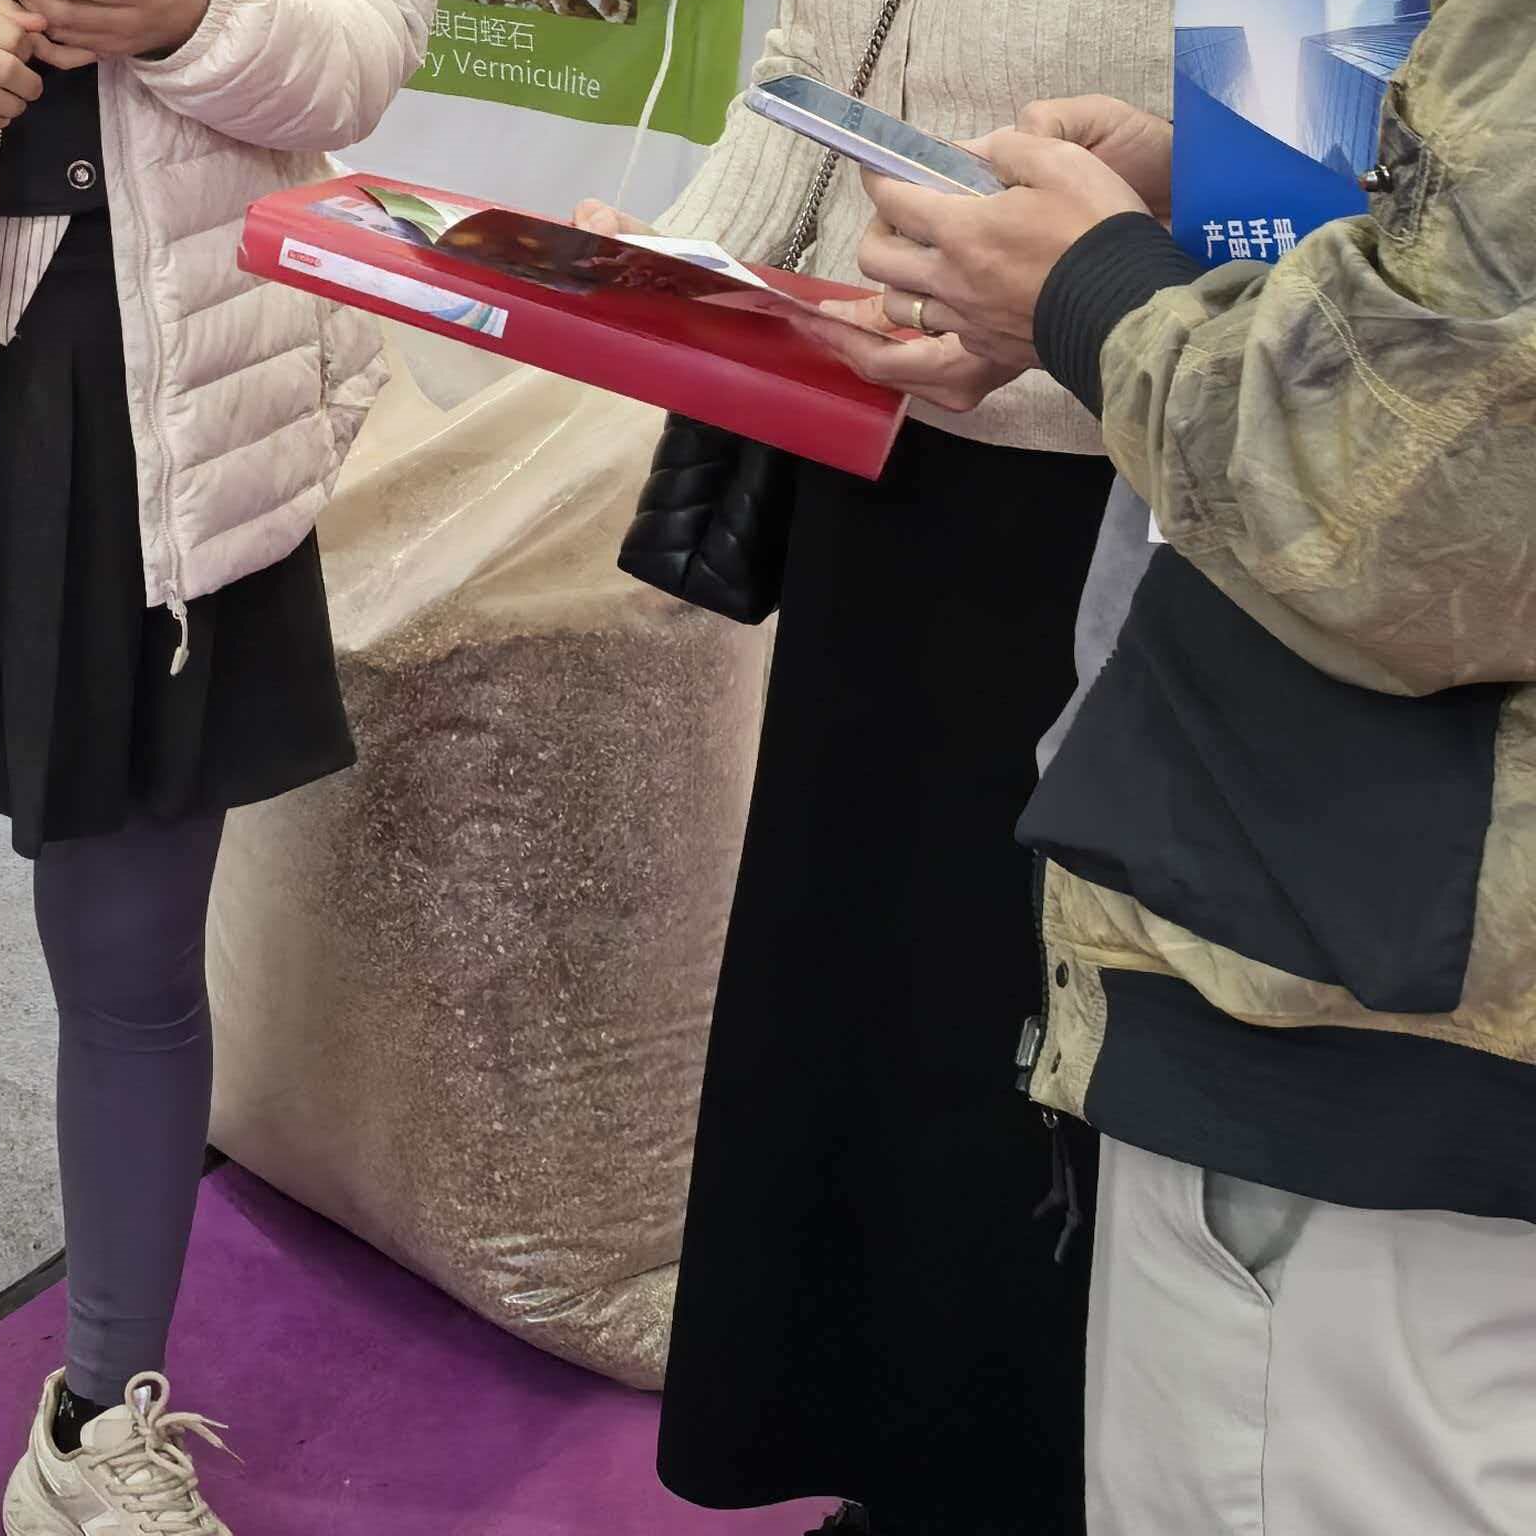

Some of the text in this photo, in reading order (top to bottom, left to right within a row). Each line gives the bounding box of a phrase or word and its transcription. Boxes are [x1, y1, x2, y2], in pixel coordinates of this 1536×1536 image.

[452, 49, 601, 99] Vermiculite
[1203, 218, 1296, 259] 产品手册
